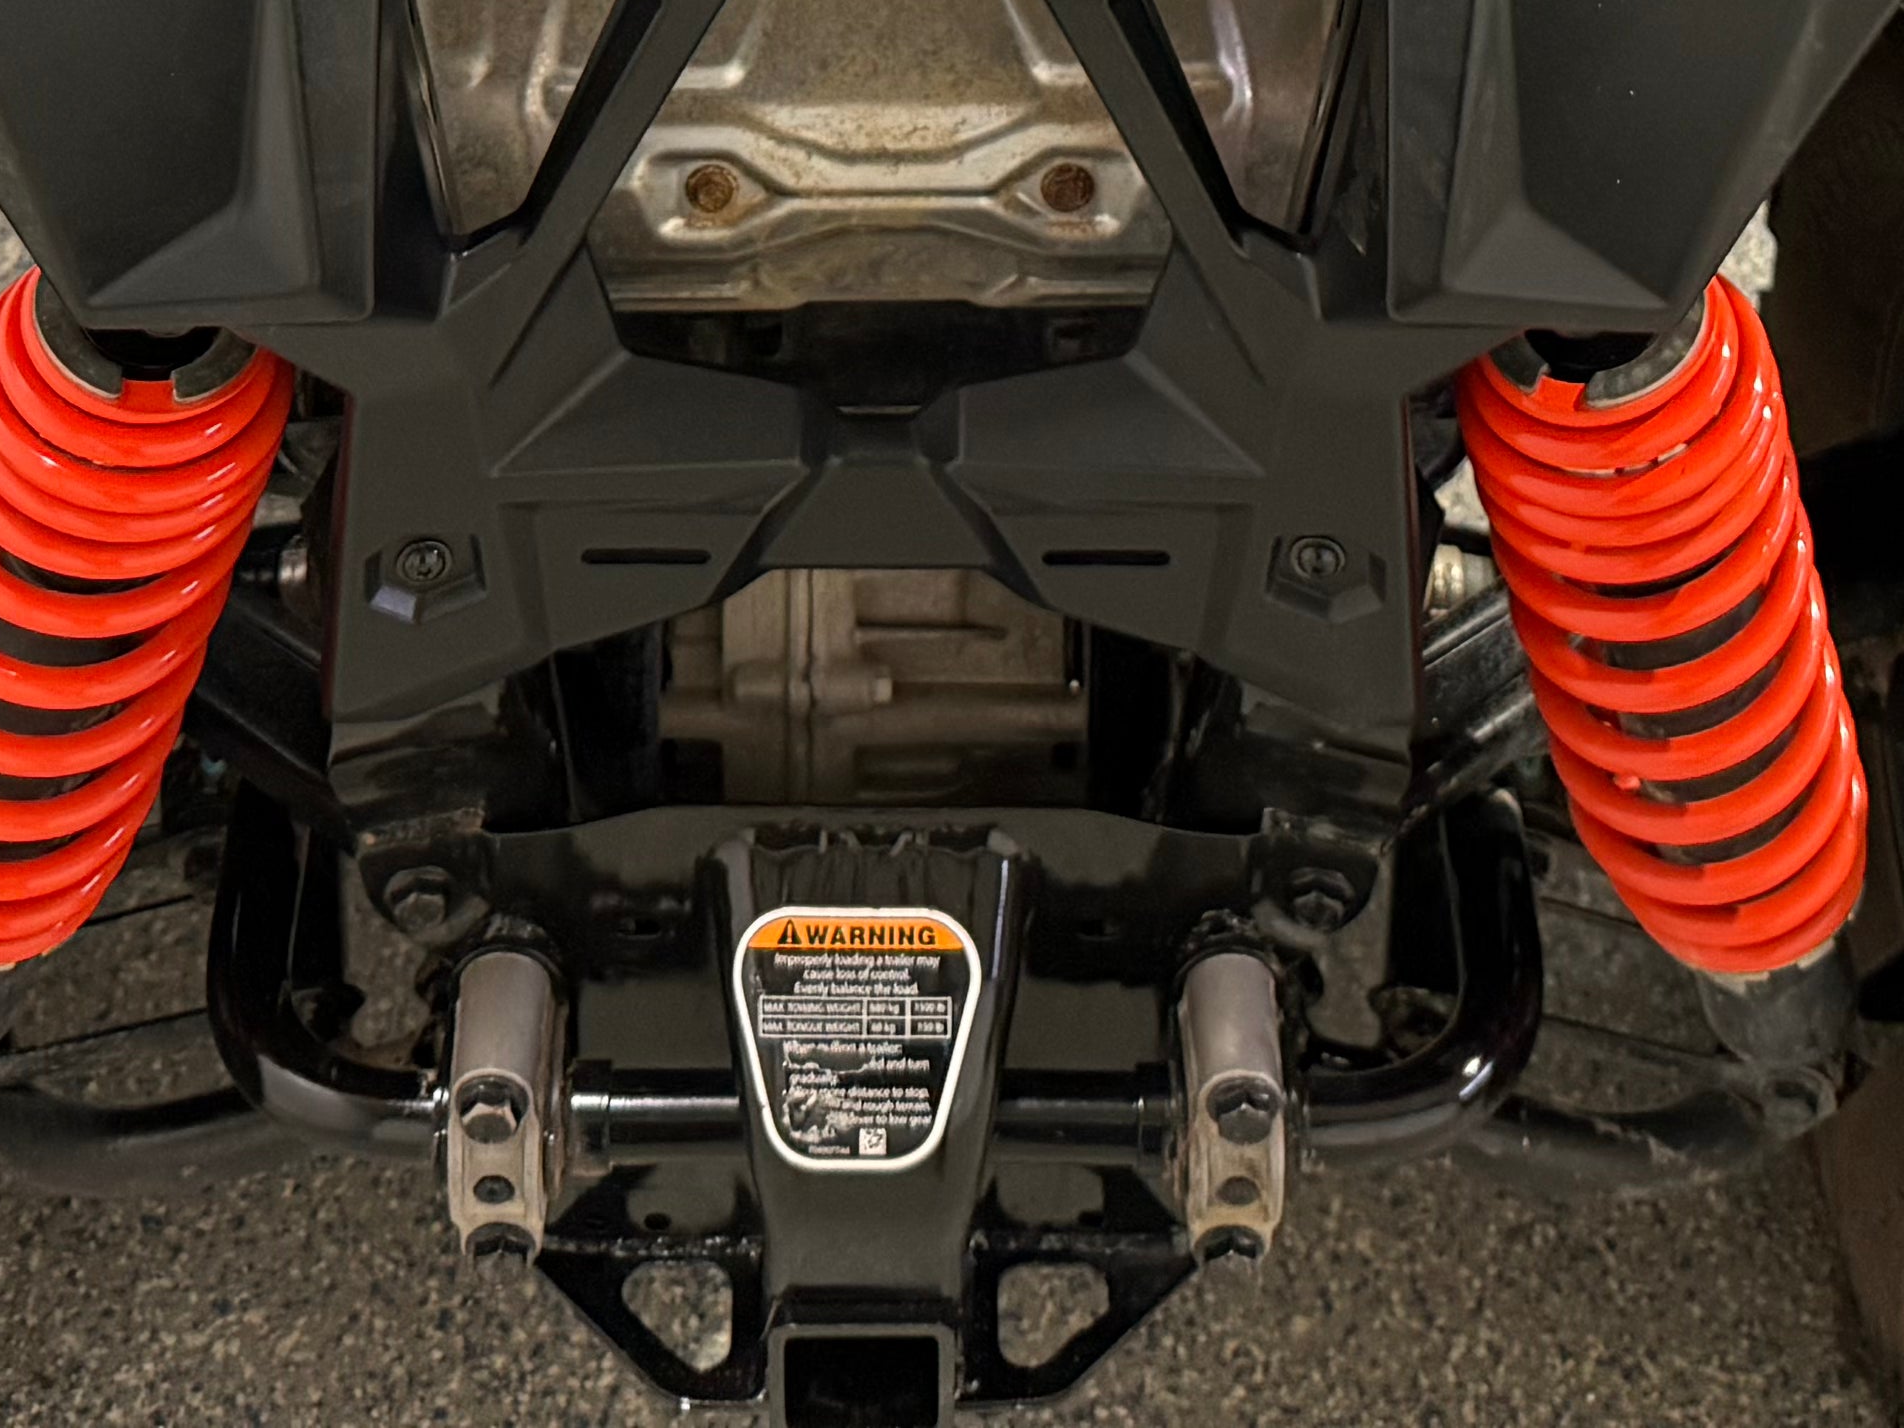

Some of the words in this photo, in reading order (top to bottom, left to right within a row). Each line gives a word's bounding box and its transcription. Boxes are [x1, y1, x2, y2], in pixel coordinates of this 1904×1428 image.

[806, 925, 936, 946] WARNING
[774, 954, 832, 968] Improperly
[834, 954, 874, 968] loading
[884, 954, 916, 966] trailer
[917, 956, 940, 968] may
[804, 971, 832, 980] cause
[836, 969, 855, 980] loss
[857, 968, 869, 980] of
[794, 983, 828, 996] Evenly
[830, 982, 873, 994] balance
[875, 983, 892, 994] the
